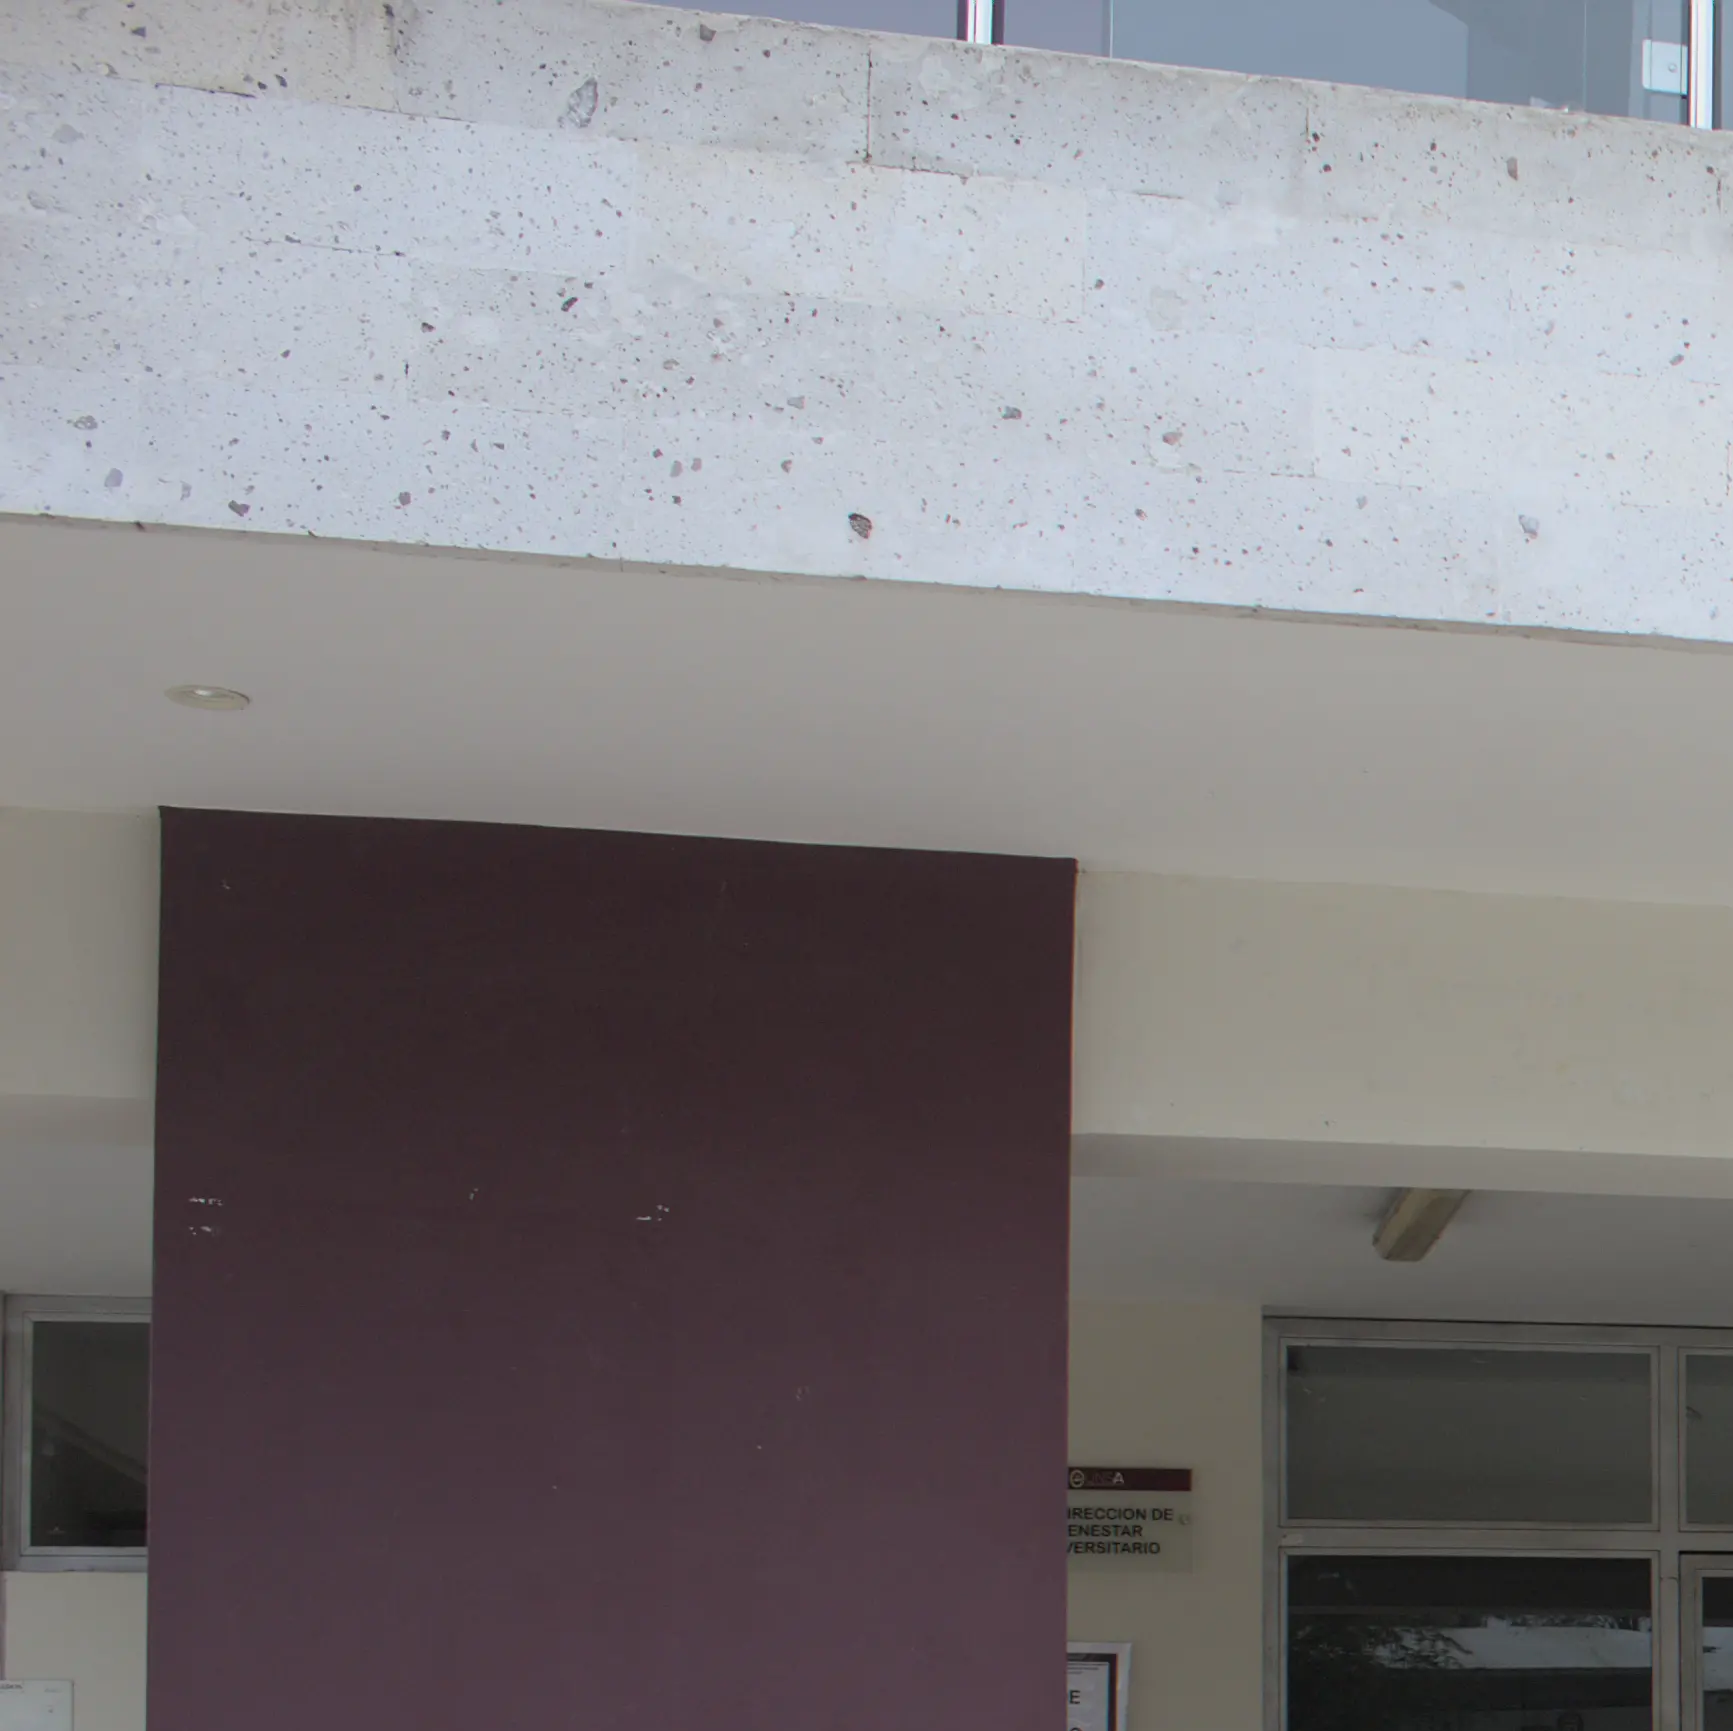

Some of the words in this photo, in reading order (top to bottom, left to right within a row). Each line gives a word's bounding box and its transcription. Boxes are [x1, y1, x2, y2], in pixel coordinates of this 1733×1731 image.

[1068, 1508, 1146, 1520] IRECCION
[1152, 1509, 1173, 1520] DE
[1068, 1525, 1143, 1537] ENESTAR
